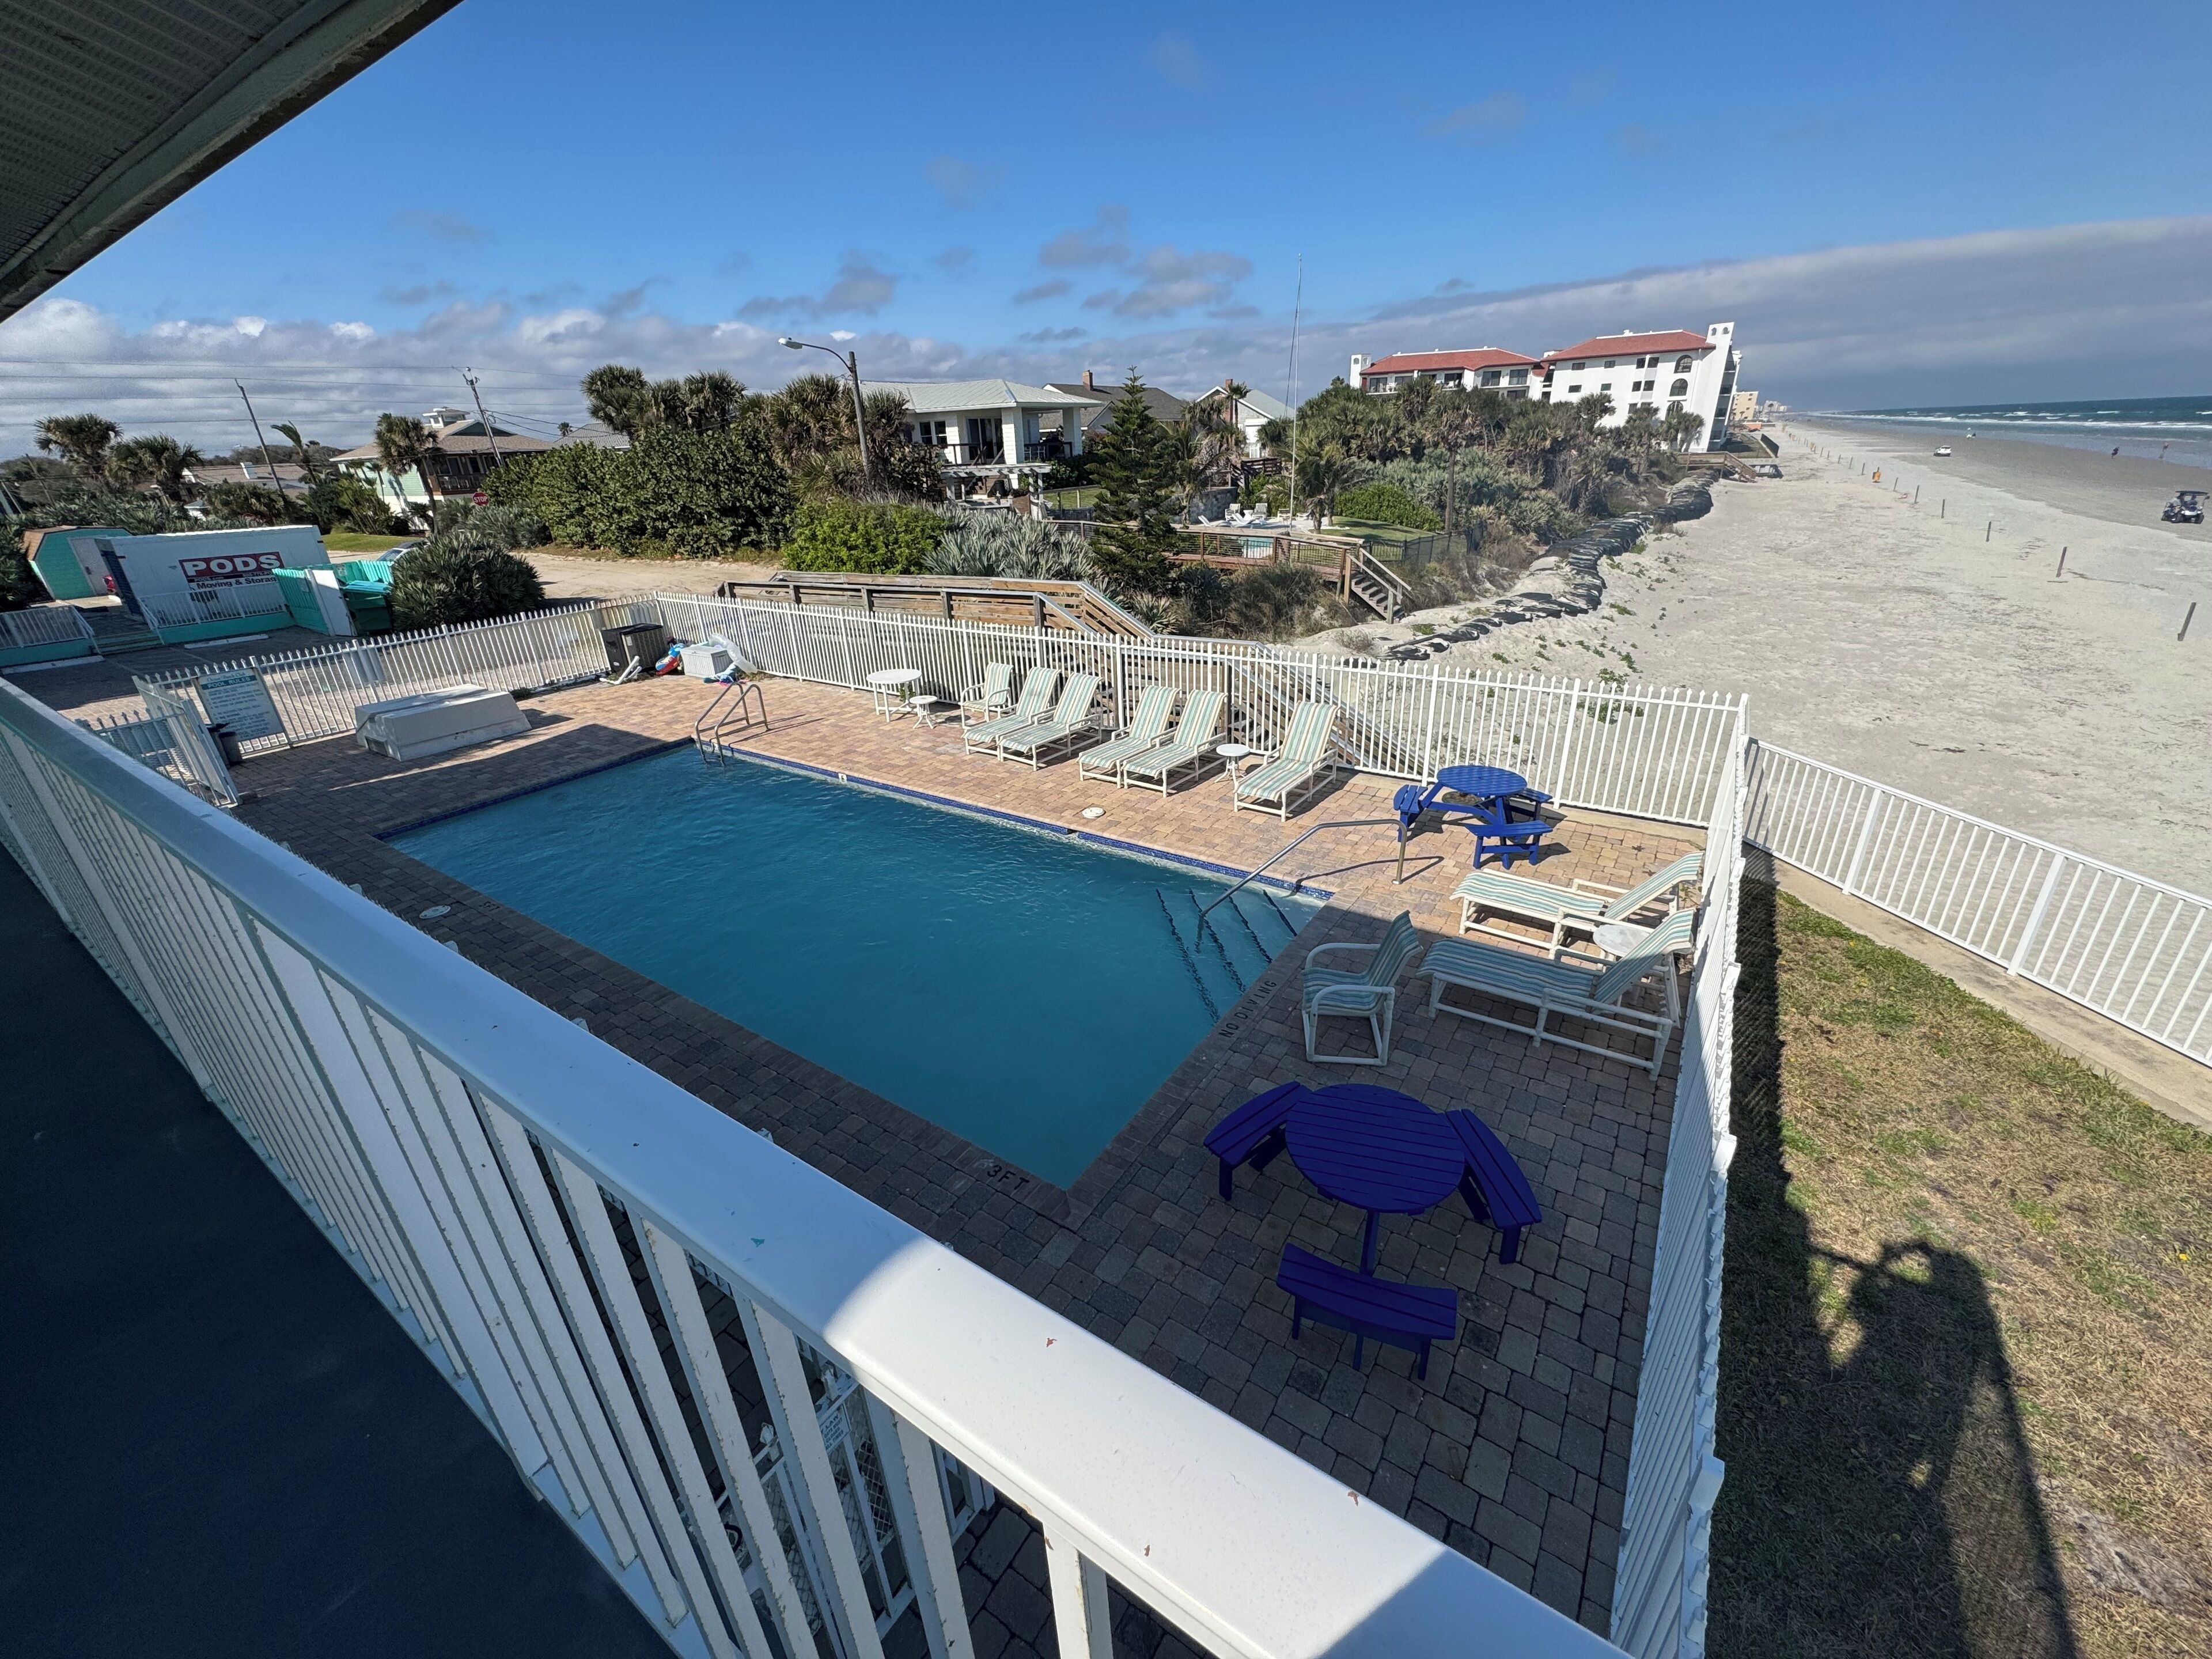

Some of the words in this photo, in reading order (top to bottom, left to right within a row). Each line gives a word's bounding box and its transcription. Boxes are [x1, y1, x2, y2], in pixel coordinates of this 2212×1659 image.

[182, 555, 281, 576] PODS
[196, 581, 233, 589] Moving
[229, 676, 251, 685] RULES
[1218, 1022, 1240, 1038] NO
[1234, 980, 1277, 1020] DIVING
[987, 1165, 1030, 1190] 3FT
[825, 1414, 839, 1430] LAW
